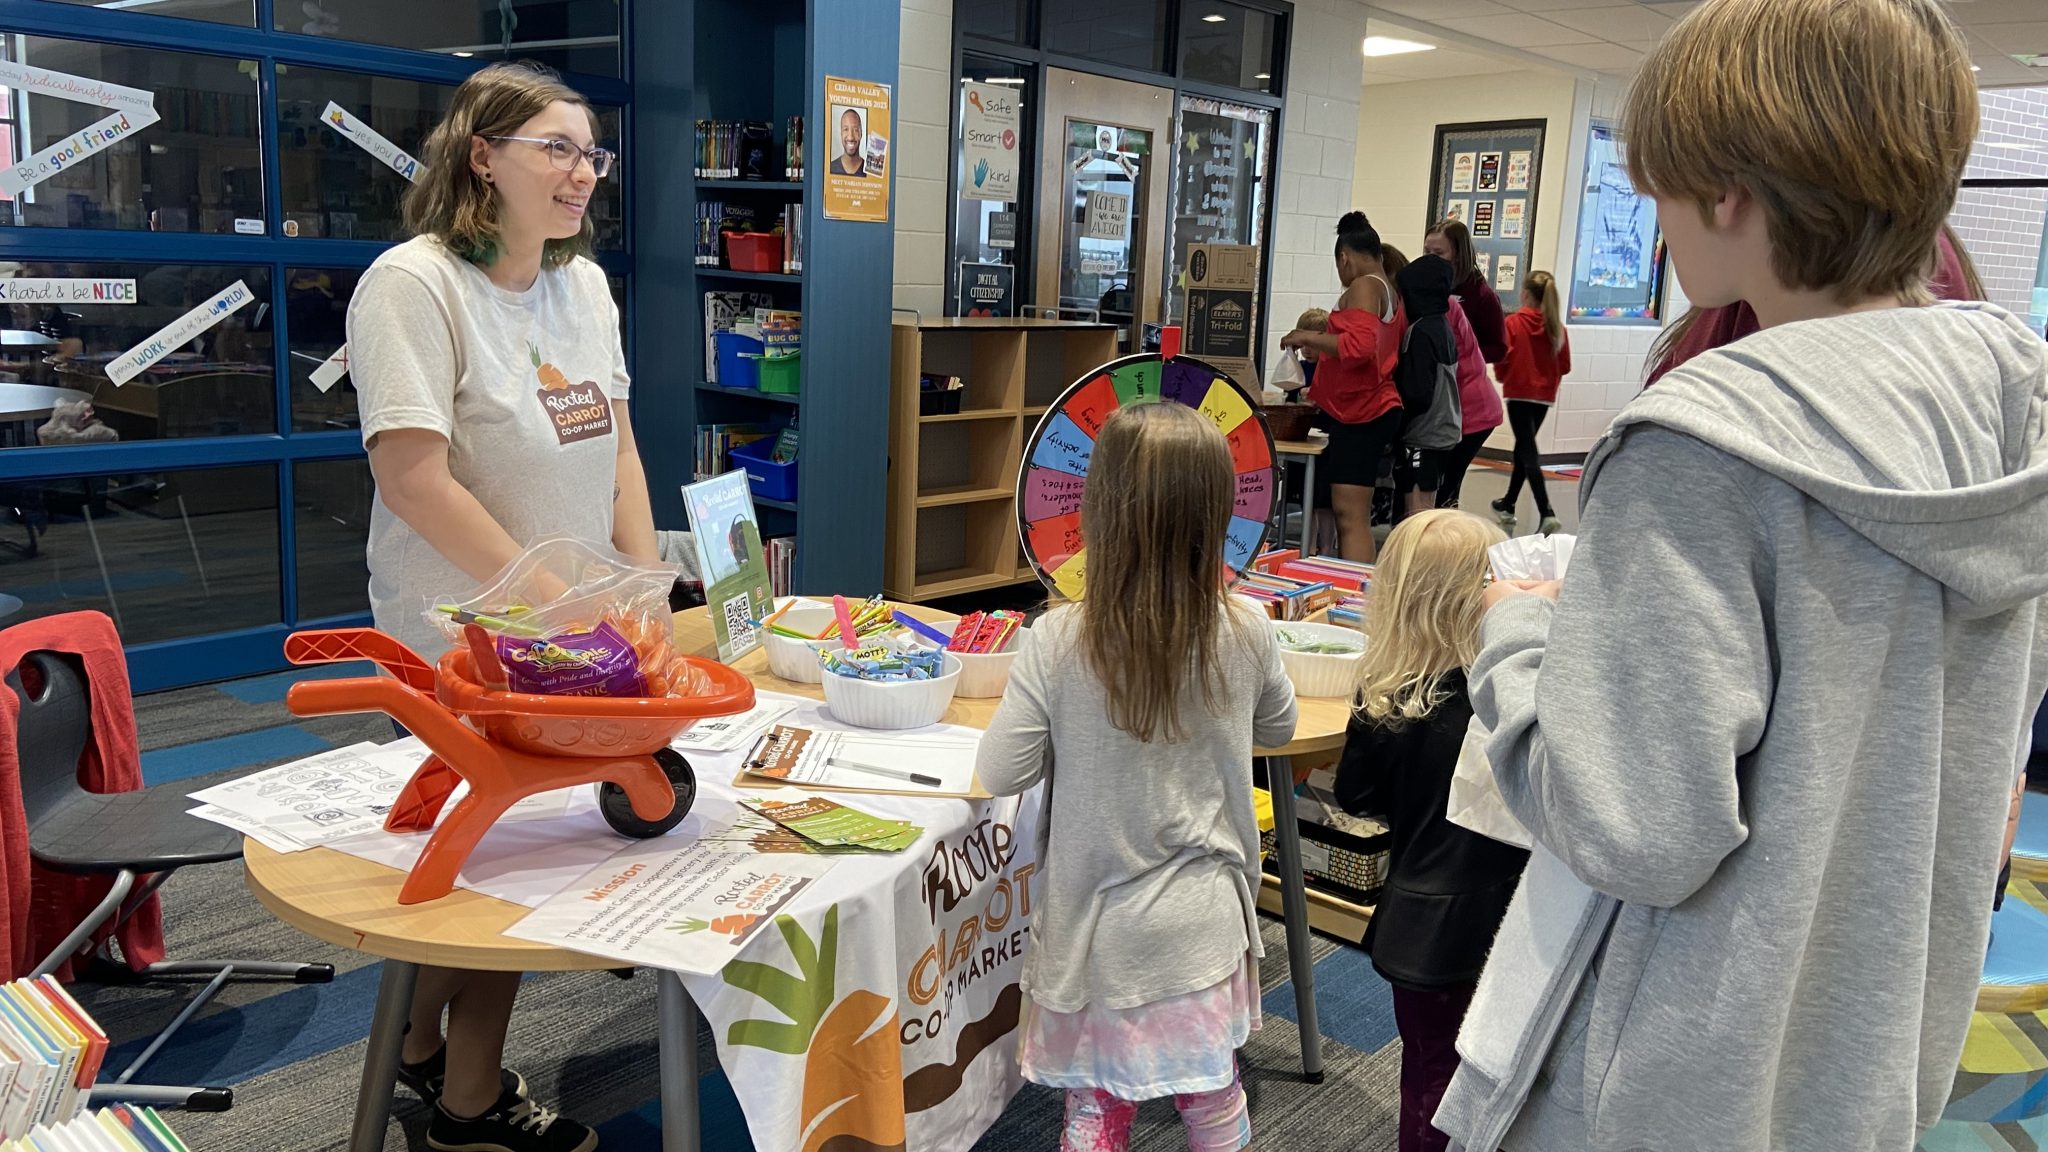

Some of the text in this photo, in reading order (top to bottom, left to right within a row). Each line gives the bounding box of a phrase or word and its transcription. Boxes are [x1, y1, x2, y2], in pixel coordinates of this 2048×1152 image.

[24, 73, 118, 105] ridiculously
[834, 83, 880, 97] CEDAR VALLEY
[986, 98, 1012, 114] Safe
[968, 130, 1002, 143] Smart
[17, 114, 131, 182] Be a good friend
[374, 143, 392, 159] you
[989, 169, 1011, 183] kind
[9, 281, 52, 300] hard
[56, 285, 64, 298] &
[72, 282, 90, 300] be
[93, 282, 134, 300] NICE
[1210, 320, 1243, 331] Tri-Fold
[788, 334, 801, 342] OF
[132, 340, 166, 366] WORK
[546, 389, 597, 412] Rooted
[556, 405, 605, 425] CARROT
[561, 419, 609, 436] CO-OP MARKET
[559, 674, 578, 683] Pride
[579, 671, 594, 680] and
[922, 815, 1018, 926] Roote
[582, 863, 647, 902] Mission
[714, 872, 765, 906] Rooted
[735, 872, 786, 910] CARROT
[772, 875, 797, 895] MARKET
[606, 928, 627, 944] that
[626, 913, 650, 930] seeks
[647, 905, 658, 914] to
[657, 882, 689, 908] enhance
[718, 852, 730, 861] an
[565, 924, 587, 939] The
[582, 904, 616, 927] Rooted
[612, 887, 641, 906] Carrot
